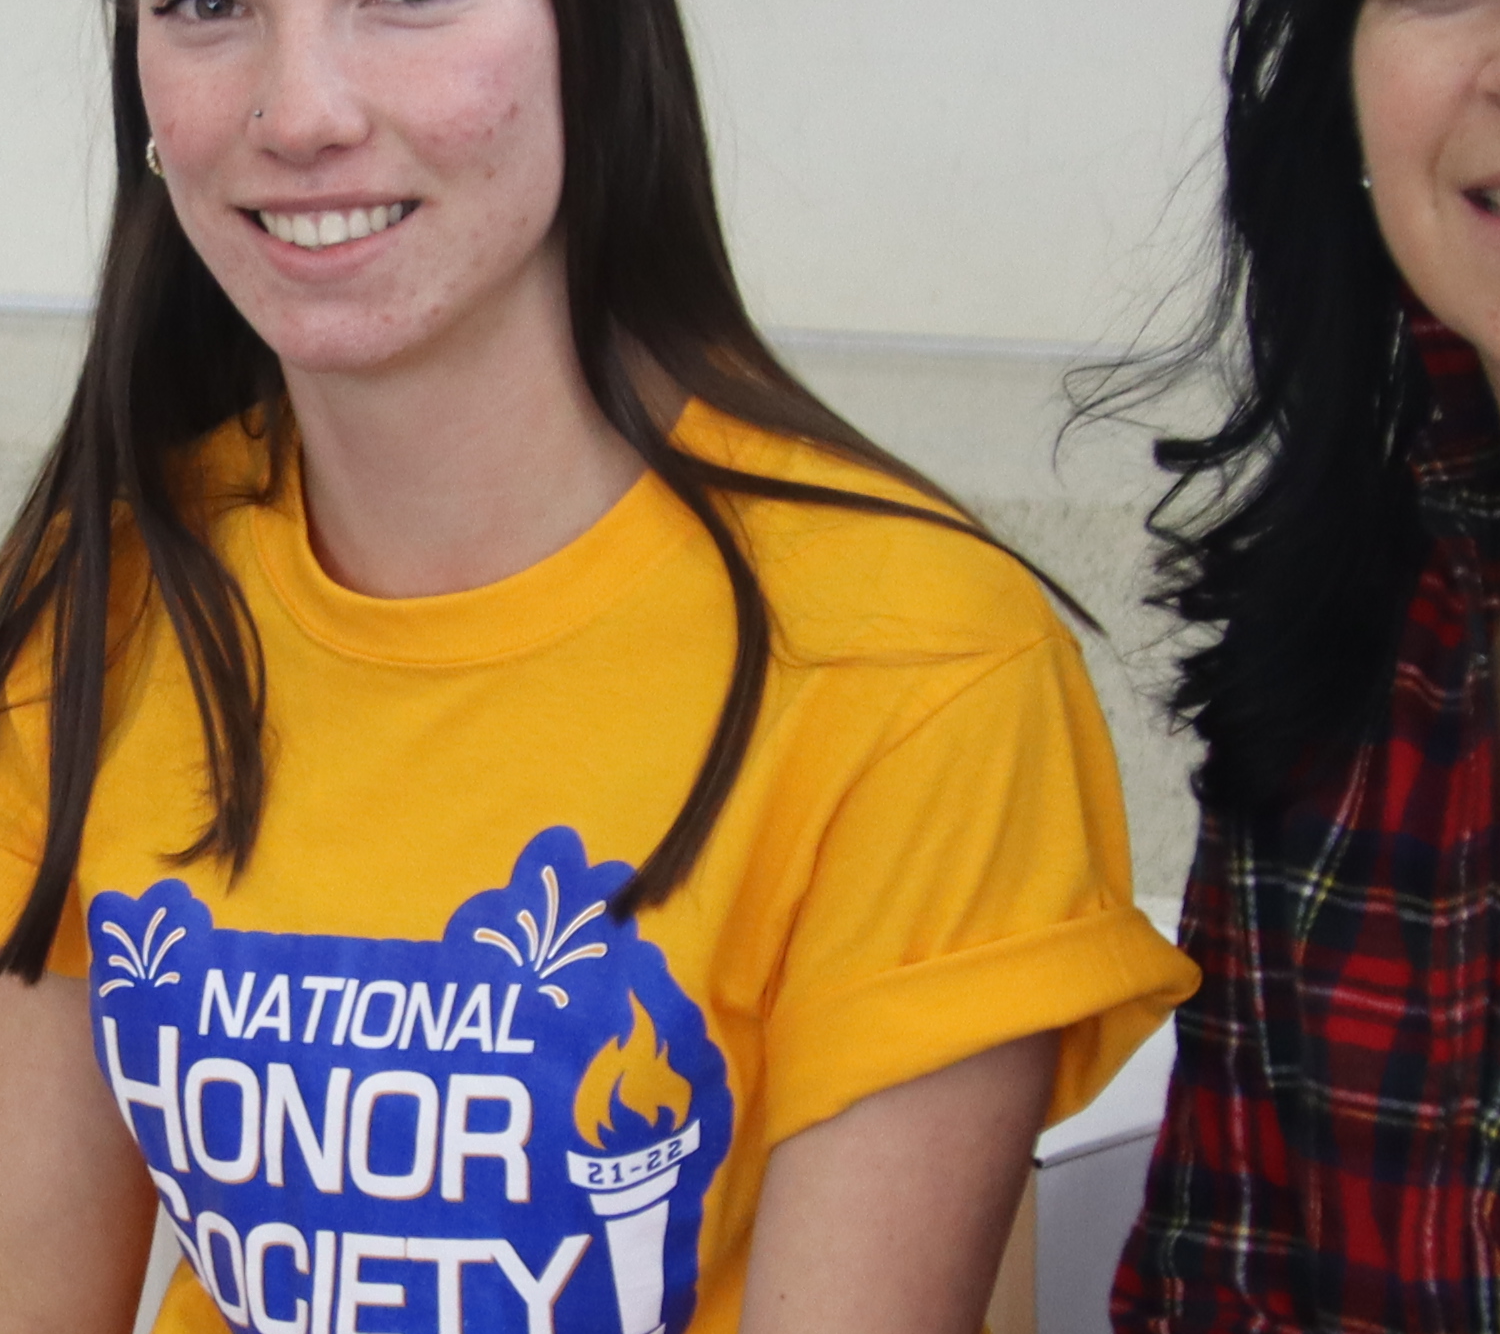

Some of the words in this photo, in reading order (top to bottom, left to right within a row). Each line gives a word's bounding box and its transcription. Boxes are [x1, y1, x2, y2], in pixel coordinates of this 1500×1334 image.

[198, 968, 536, 1054] NATIONAL
[102, 1016, 534, 1204] HONOR
[586, 1137, 686, 1187] 21-22
